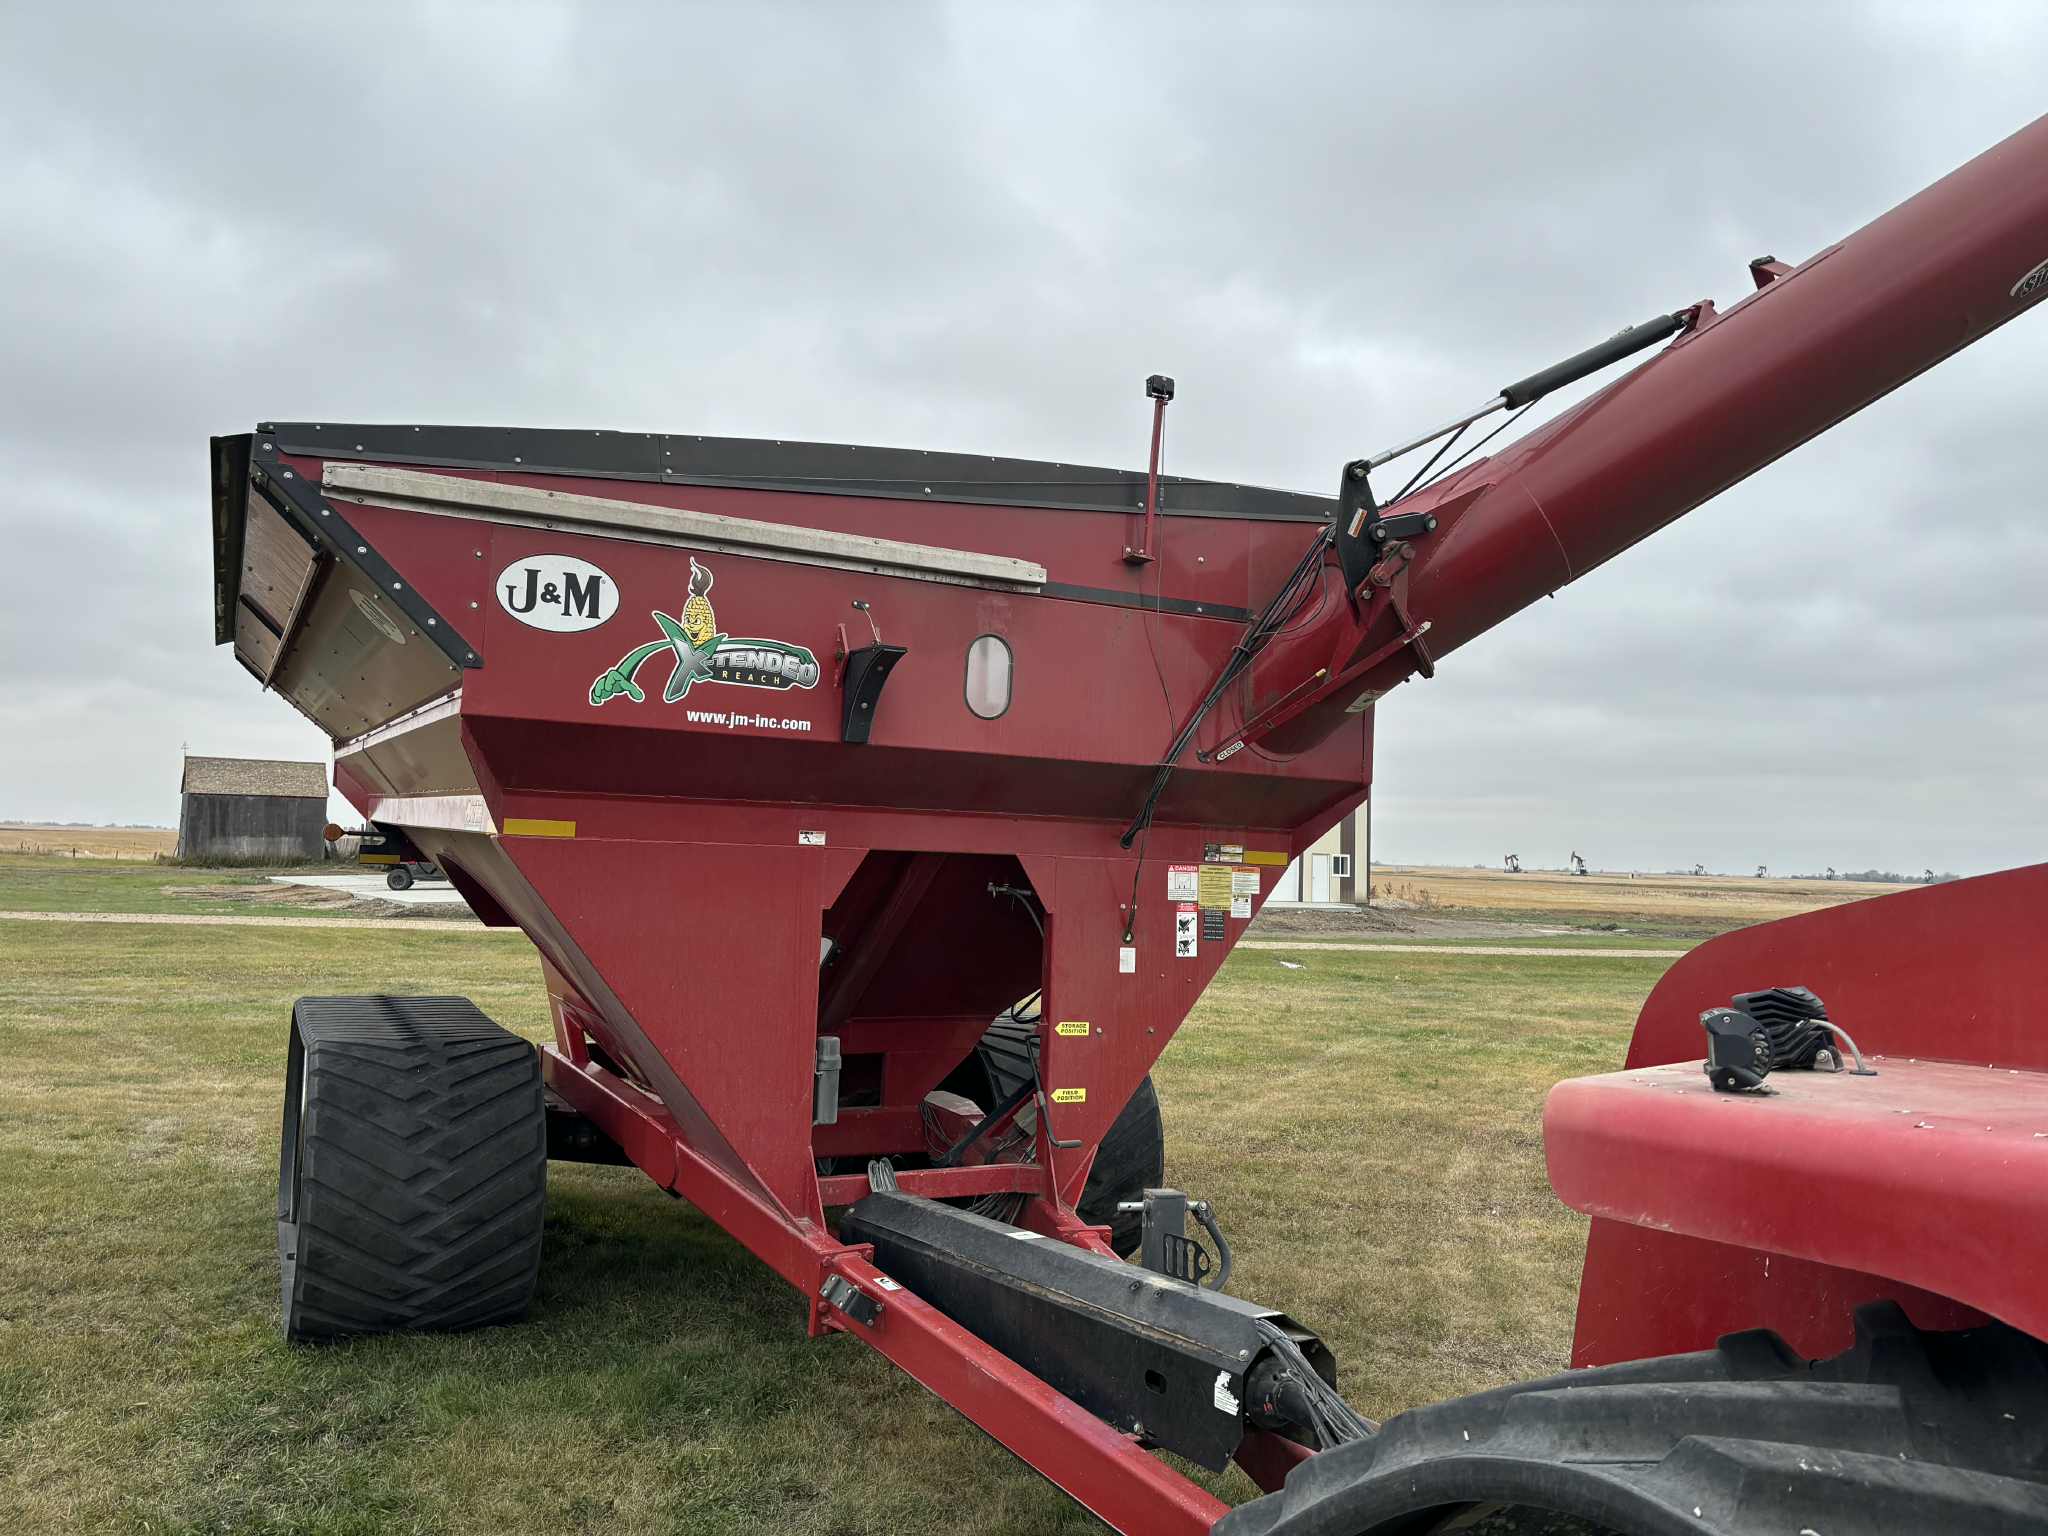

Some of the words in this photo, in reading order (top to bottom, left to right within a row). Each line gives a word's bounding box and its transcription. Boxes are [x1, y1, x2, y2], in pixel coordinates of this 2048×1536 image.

[506, 568, 603, 619] J&M
[722, 670, 780, 685] REACH
[686, 710, 811, 731] www.jm-inc.com
[1219, 742, 1242, 759] CLOSED
